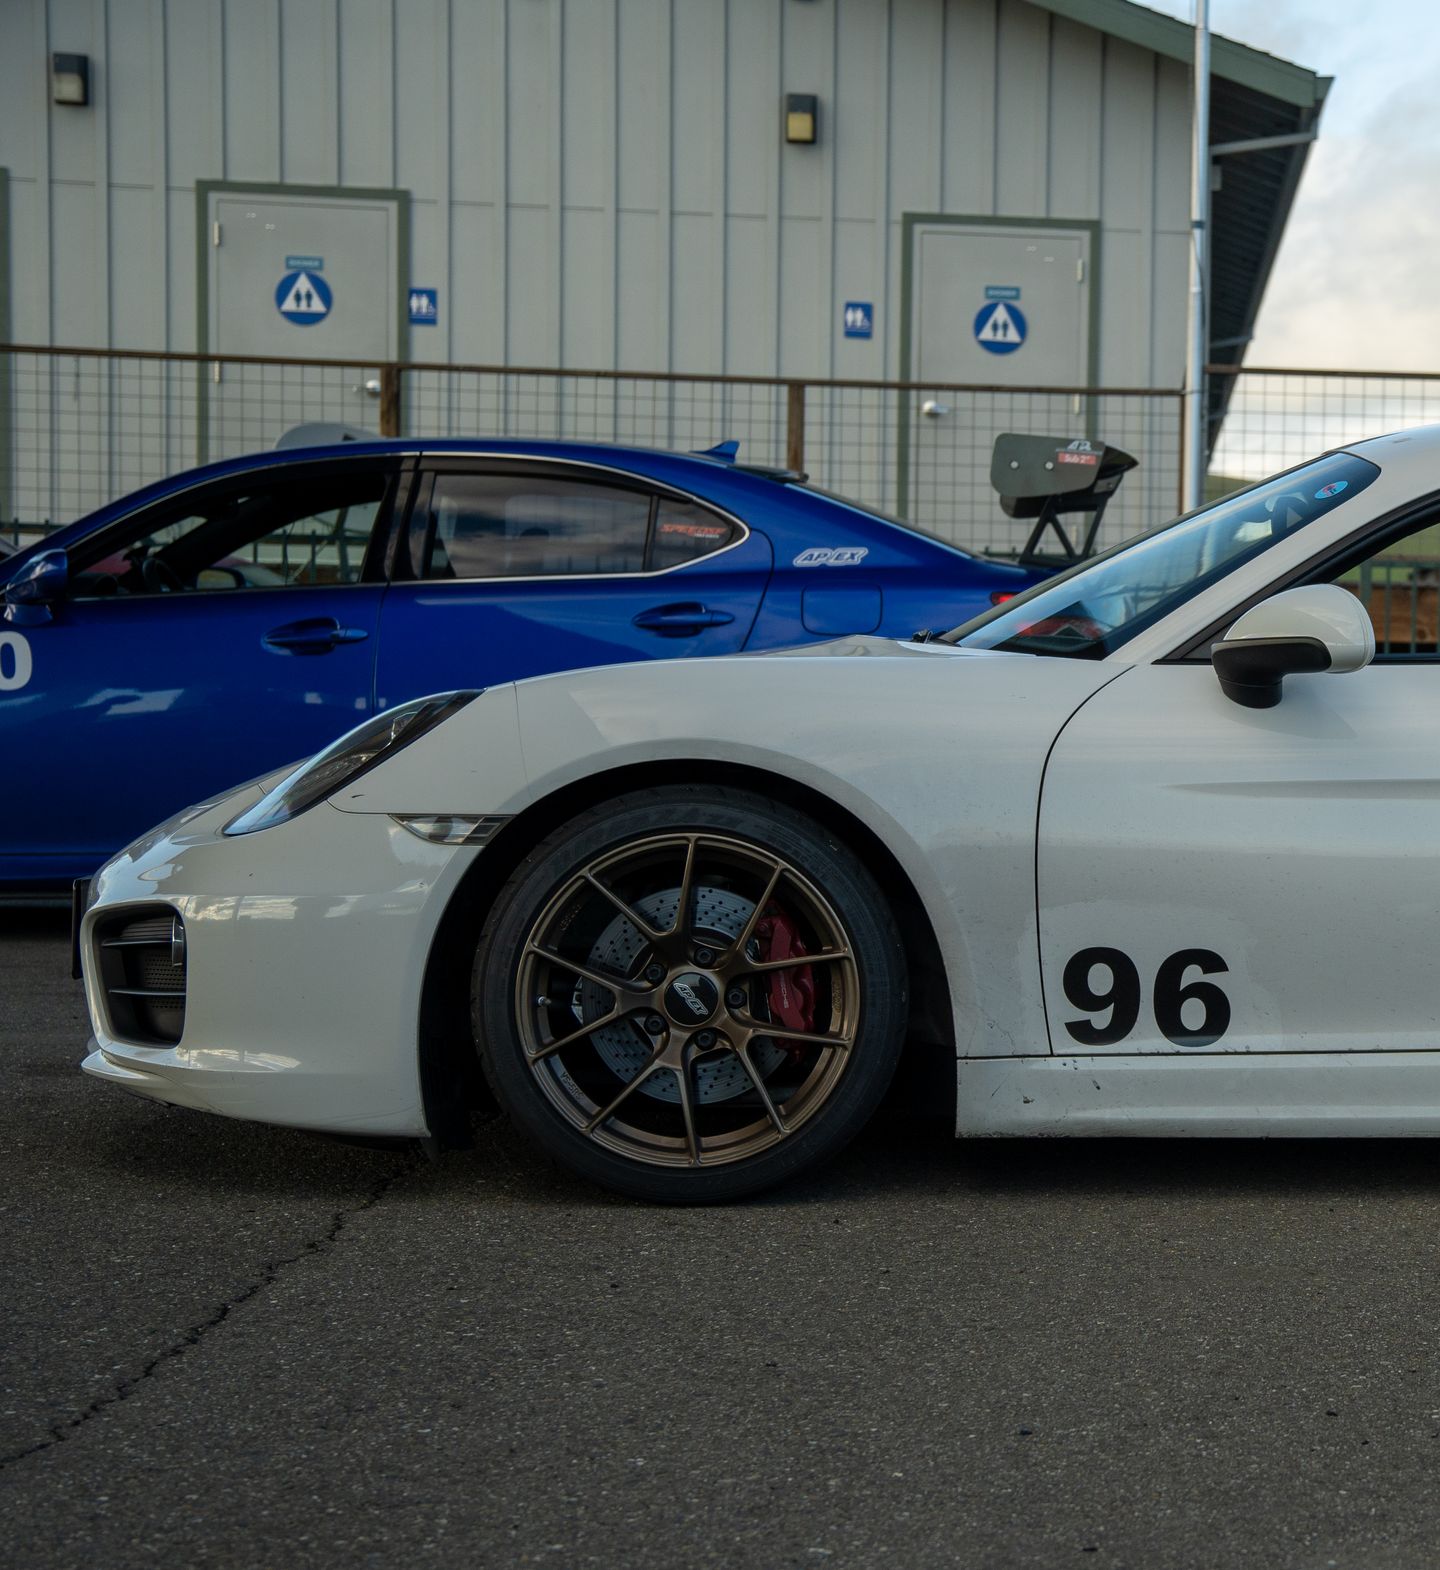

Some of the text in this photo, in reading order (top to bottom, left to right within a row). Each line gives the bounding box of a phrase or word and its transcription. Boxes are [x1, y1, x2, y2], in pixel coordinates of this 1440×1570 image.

[793, 547, 869, 567] APEX
[673, 982, 709, 1016] APEX
[1062, 946, 1231, 1047] 96
